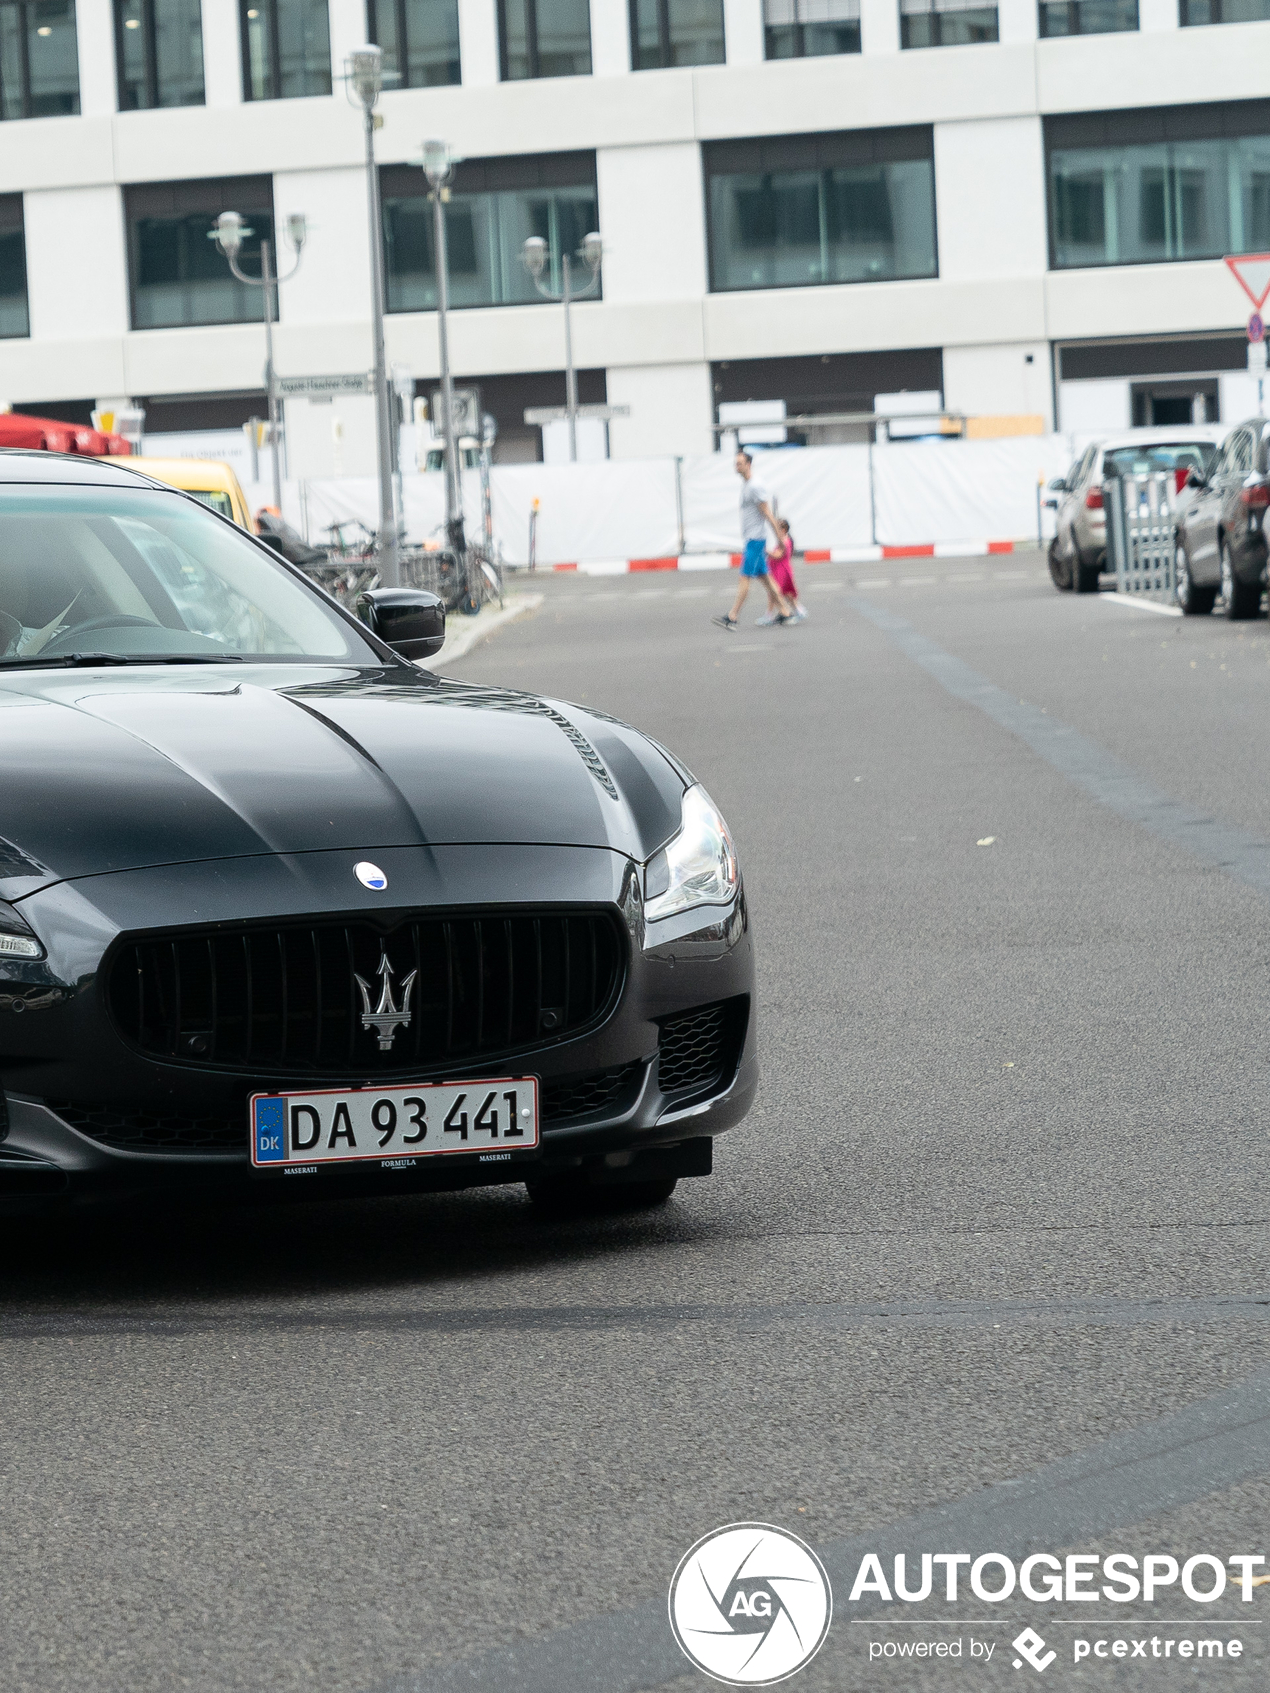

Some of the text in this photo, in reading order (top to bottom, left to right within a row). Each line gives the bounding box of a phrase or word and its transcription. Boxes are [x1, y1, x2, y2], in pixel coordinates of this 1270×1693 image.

[291, 1090, 524, 1150] DA 93 441
[260, 1136, 279, 1151] DK
[479, 1153, 511, 1162] MASERATI
[381, 1159, 417, 1168] FORMULA
[284, 1167, 317, 1175] MASERATI
